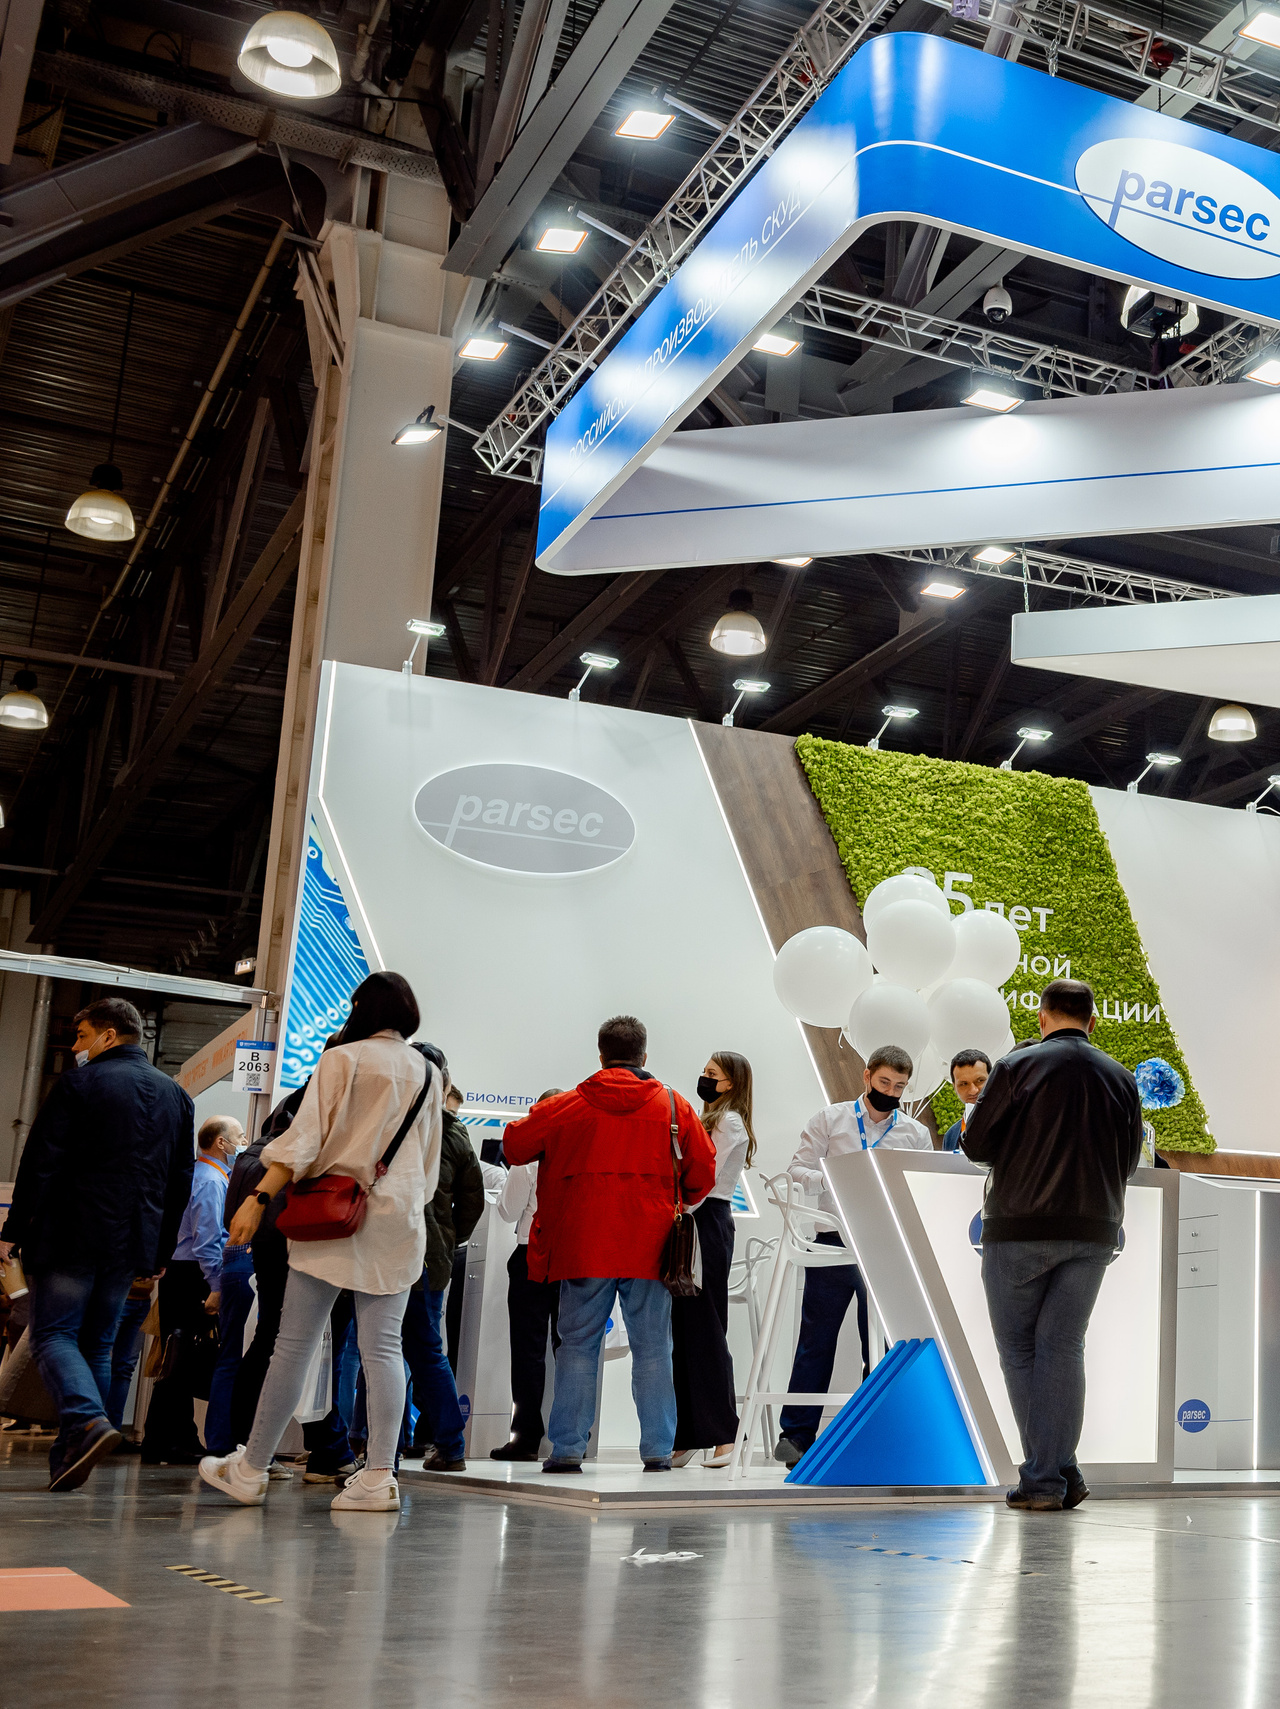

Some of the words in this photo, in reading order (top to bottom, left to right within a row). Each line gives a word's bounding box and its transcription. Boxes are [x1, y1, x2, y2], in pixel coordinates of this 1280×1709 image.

[1108, 169, 1271, 241] parsec
[444, 794, 604, 848] parsec
[902, 866, 974, 921] 5
[1017, 953, 1071, 979] НОЙ
[238, 1061, 270, 1073] 2063
[251, 1052, 260, 1062] B
[1181, 1408, 1206, 1428] parsec
